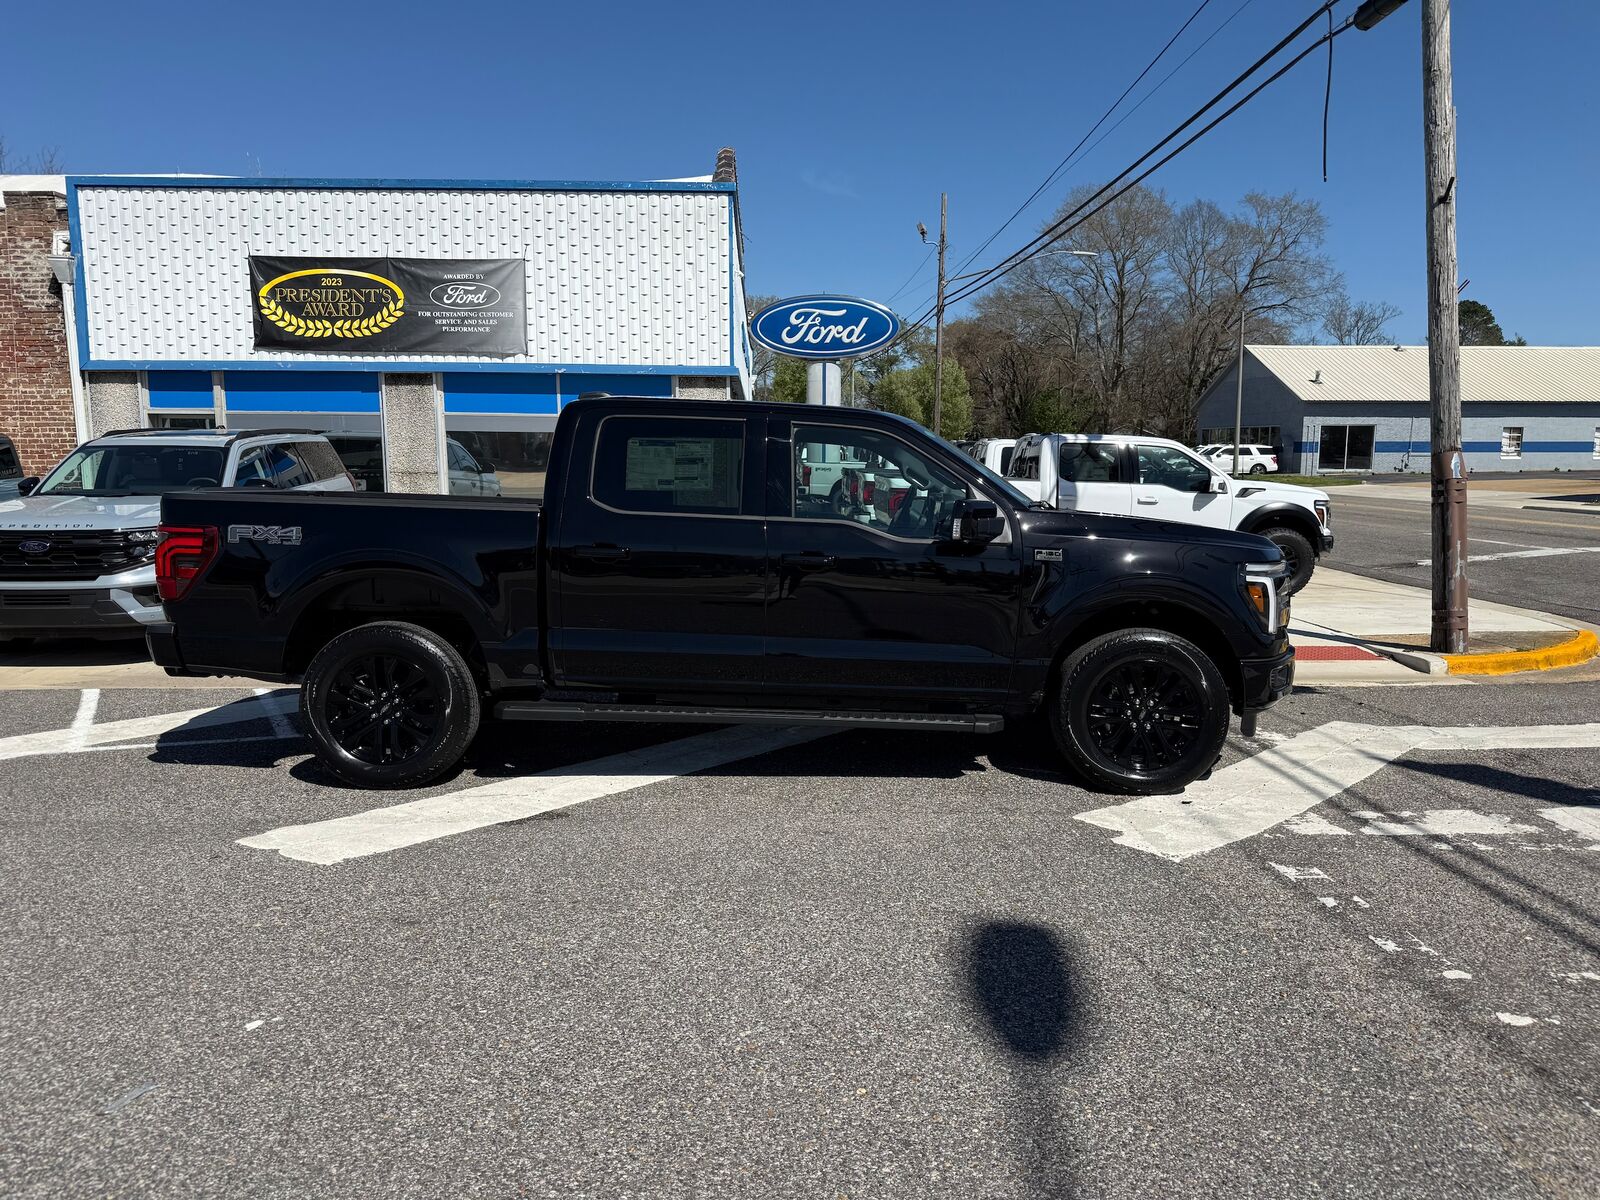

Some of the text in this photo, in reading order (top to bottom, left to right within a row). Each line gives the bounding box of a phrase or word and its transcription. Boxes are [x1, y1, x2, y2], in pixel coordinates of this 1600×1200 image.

[321, 277, 343, 286] 2023
[275, 287, 393, 303] PRESIDENT'S
[443, 285, 488, 304] Ford
[301, 302, 365, 317] AWARD
[781, 308, 869, 344] Ford
[228, 524, 303, 544] FX4
